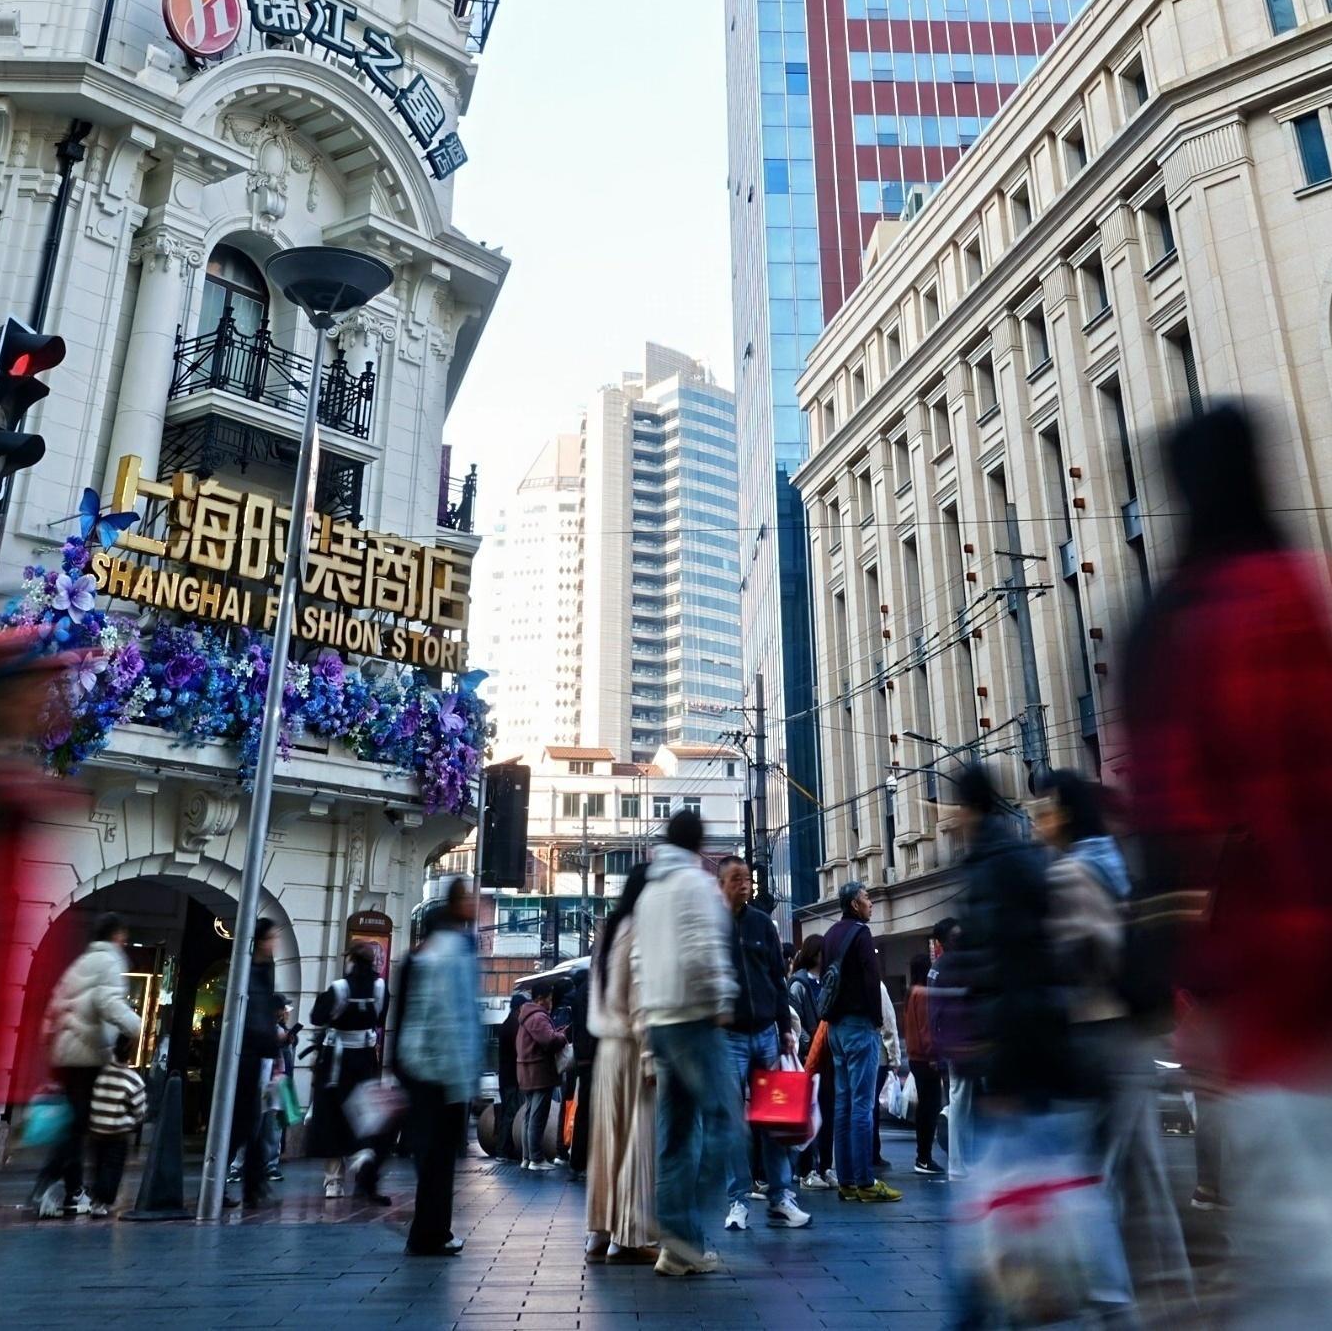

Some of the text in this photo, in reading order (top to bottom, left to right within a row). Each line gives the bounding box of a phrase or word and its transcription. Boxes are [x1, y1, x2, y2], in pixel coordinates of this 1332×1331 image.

[91, 552, 470, 671] SHANGHAI FSHION STORE
[112, 454, 472, 631] 上海时装商店
